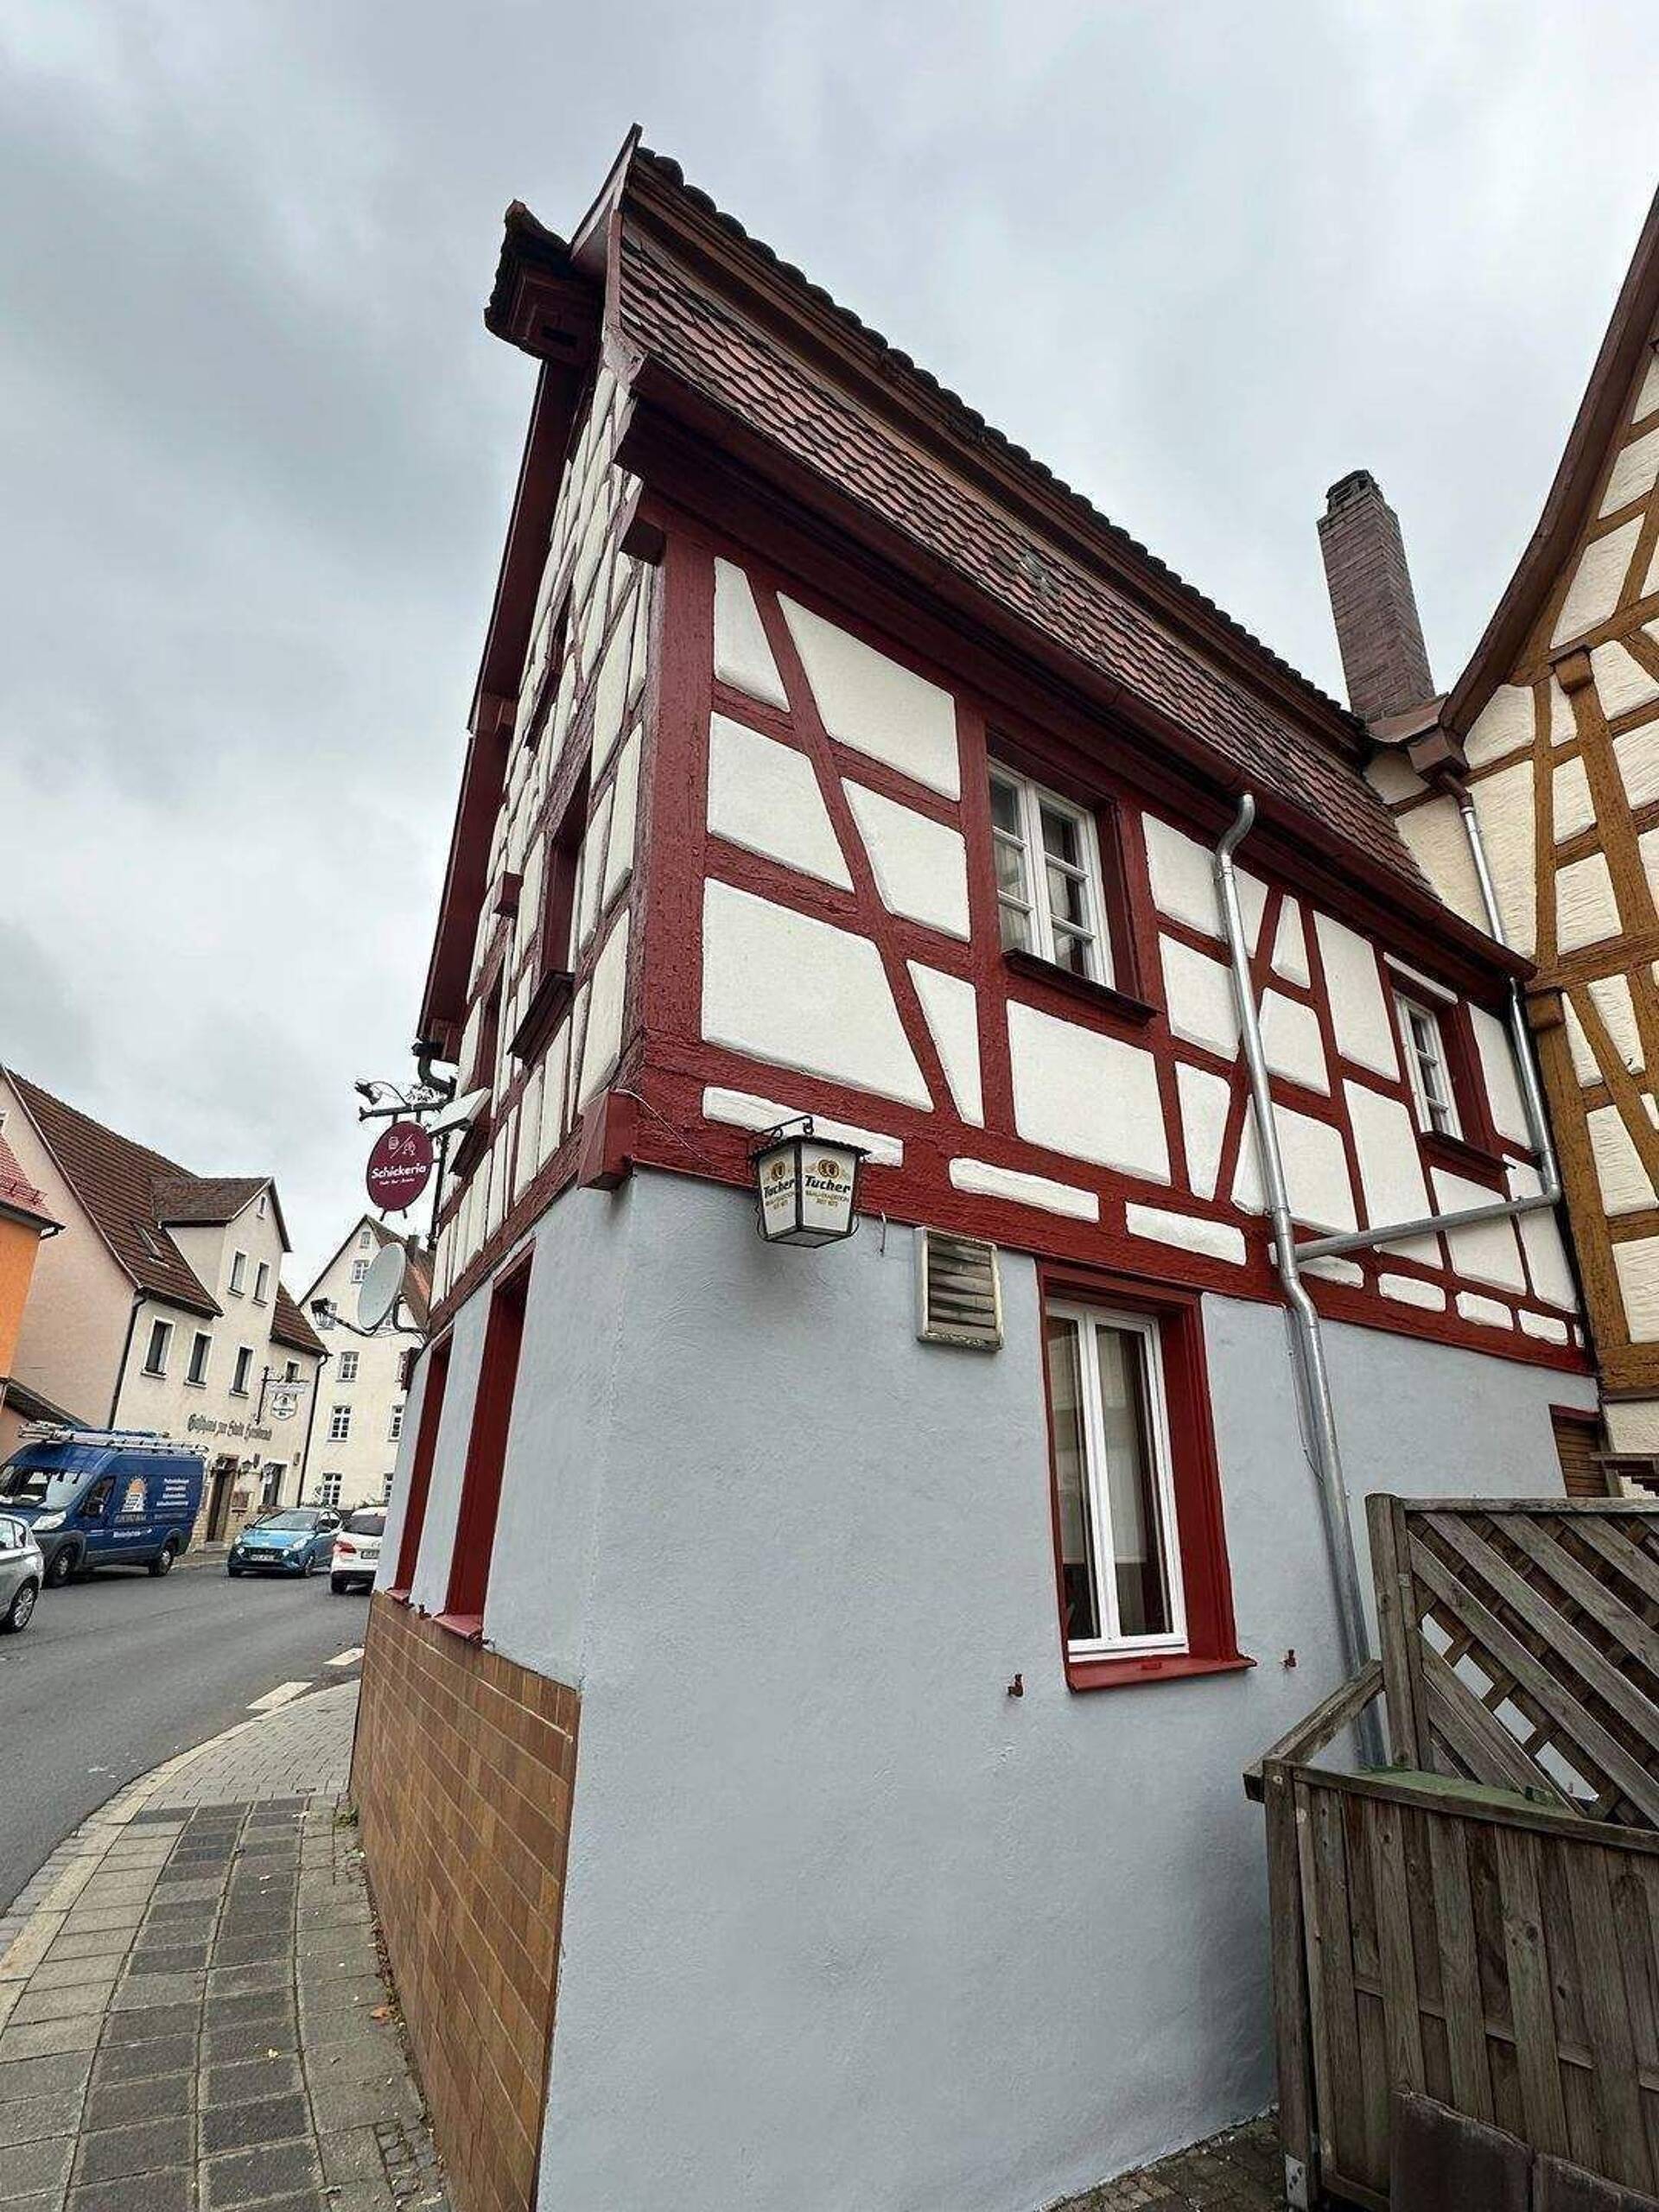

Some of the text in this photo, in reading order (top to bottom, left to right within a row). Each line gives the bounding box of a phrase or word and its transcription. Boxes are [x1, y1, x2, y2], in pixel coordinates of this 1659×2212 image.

[372, 1163, 426, 1179] Schickeria
[763, 1178, 795, 1198] Tucher
[804, 1174, 851, 1194] Tucher
